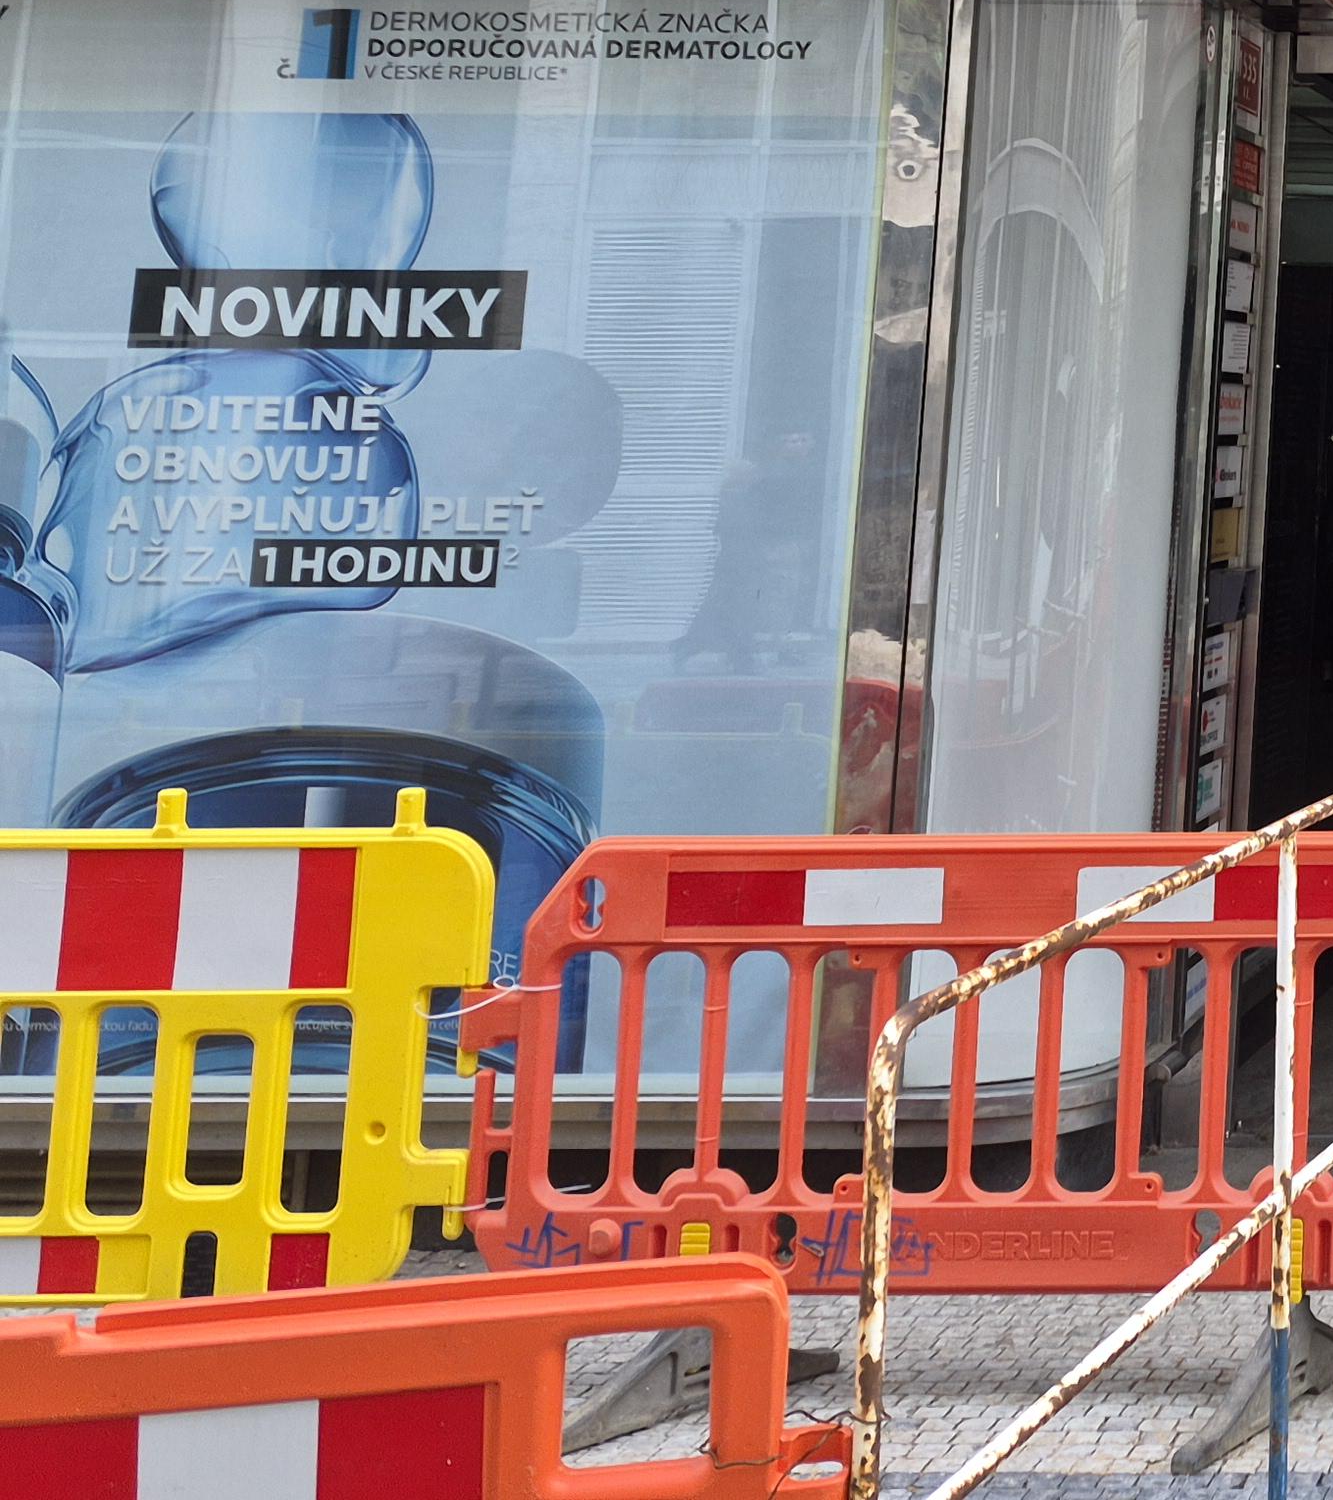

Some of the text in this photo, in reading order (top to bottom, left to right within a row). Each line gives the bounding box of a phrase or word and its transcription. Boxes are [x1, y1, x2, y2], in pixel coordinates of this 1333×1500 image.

[311, 8, 354, 81] 1
[369, 9, 770, 35] DERMOKOSMETICKÁ ZNAČKA
[364, 65, 376, 80] V
[380, 61, 444, 80] ČESKÉ
[366, 33, 814, 62] DOPORUČOVANÁ DERMATOLOGY
[157, 285, 503, 339] NOVINKY
[120, 386, 383, 433] VIDITELNĚ
[113, 436, 378, 483] OBNOVUJÍ
[106, 486, 545, 536] A VYPLŇUJÍ PLEŤ
[104, 539, 171, 585] UŽ
[181, 545, 248, 585] ZA
[258, 546, 277, 583] 1
[290, 545, 495, 584] HODINU
